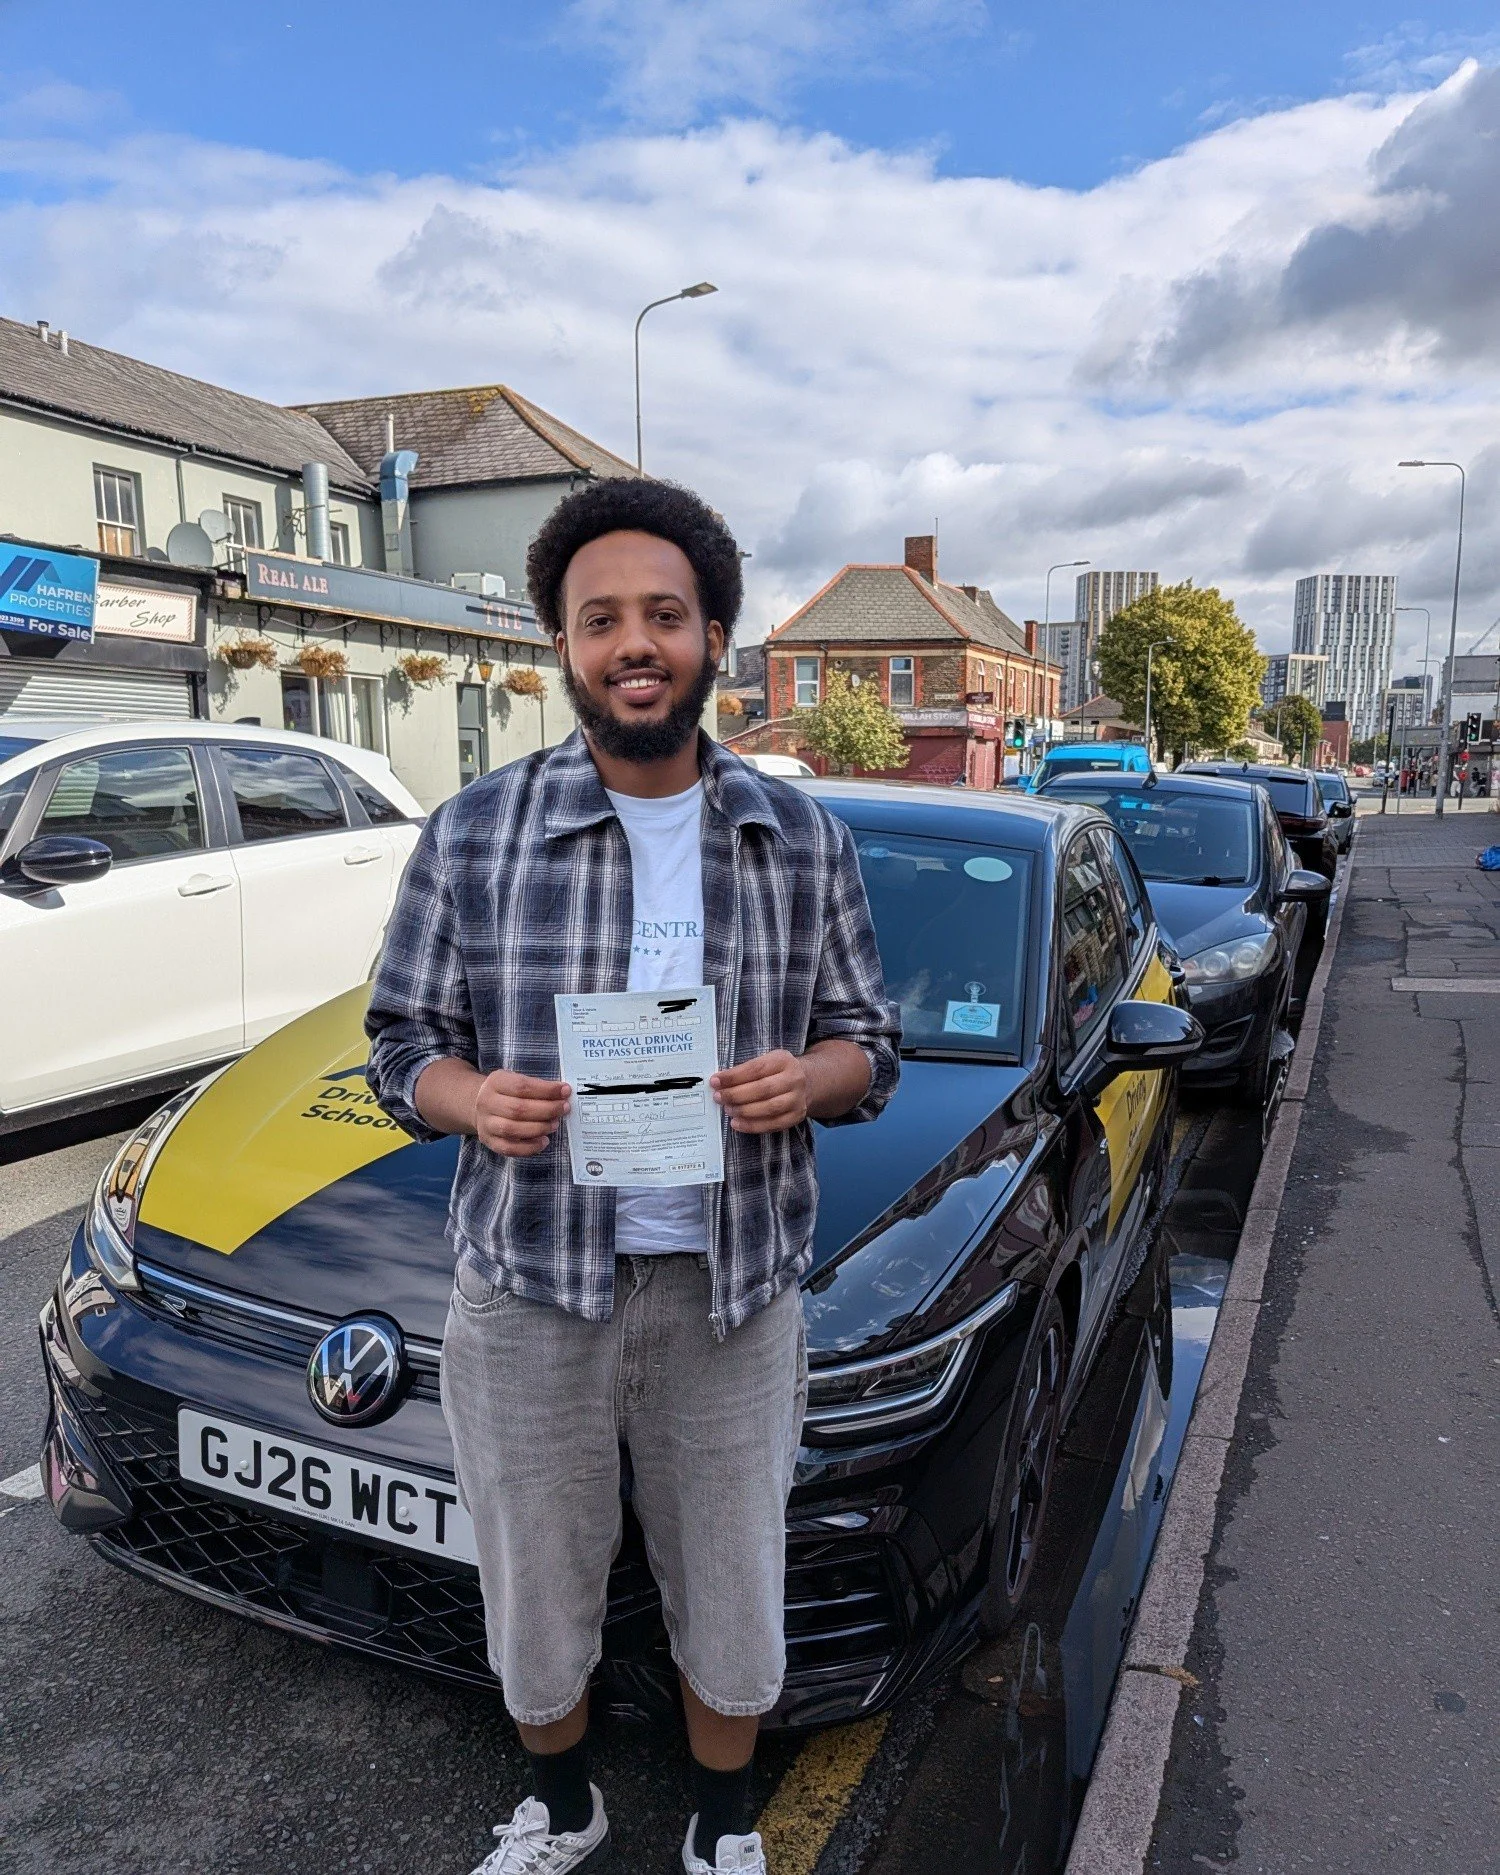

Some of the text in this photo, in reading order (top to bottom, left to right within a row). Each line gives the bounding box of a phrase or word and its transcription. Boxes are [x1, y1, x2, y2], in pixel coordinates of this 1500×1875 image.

[258, 563, 329, 595] REAL ALE
[37, 584, 93, 604] HAFREN
[10, 593, 92, 617] PROPERTIES
[130, 610, 177, 628] Shop
[483, 603, 523, 631] THE
[28, 618, 91, 640] For Sale
[933, 712, 961, 721] STORE
[633, 919, 704, 938] CENTR
[582, 1032, 693, 1048] PRACTICAL DRIVING
[583, 1043, 693, 1058] TEST PASS CERTIFICATE
[317, 1086, 379, 1105] Driv
[201, 1426, 457, 1544] GJ26 WCT
